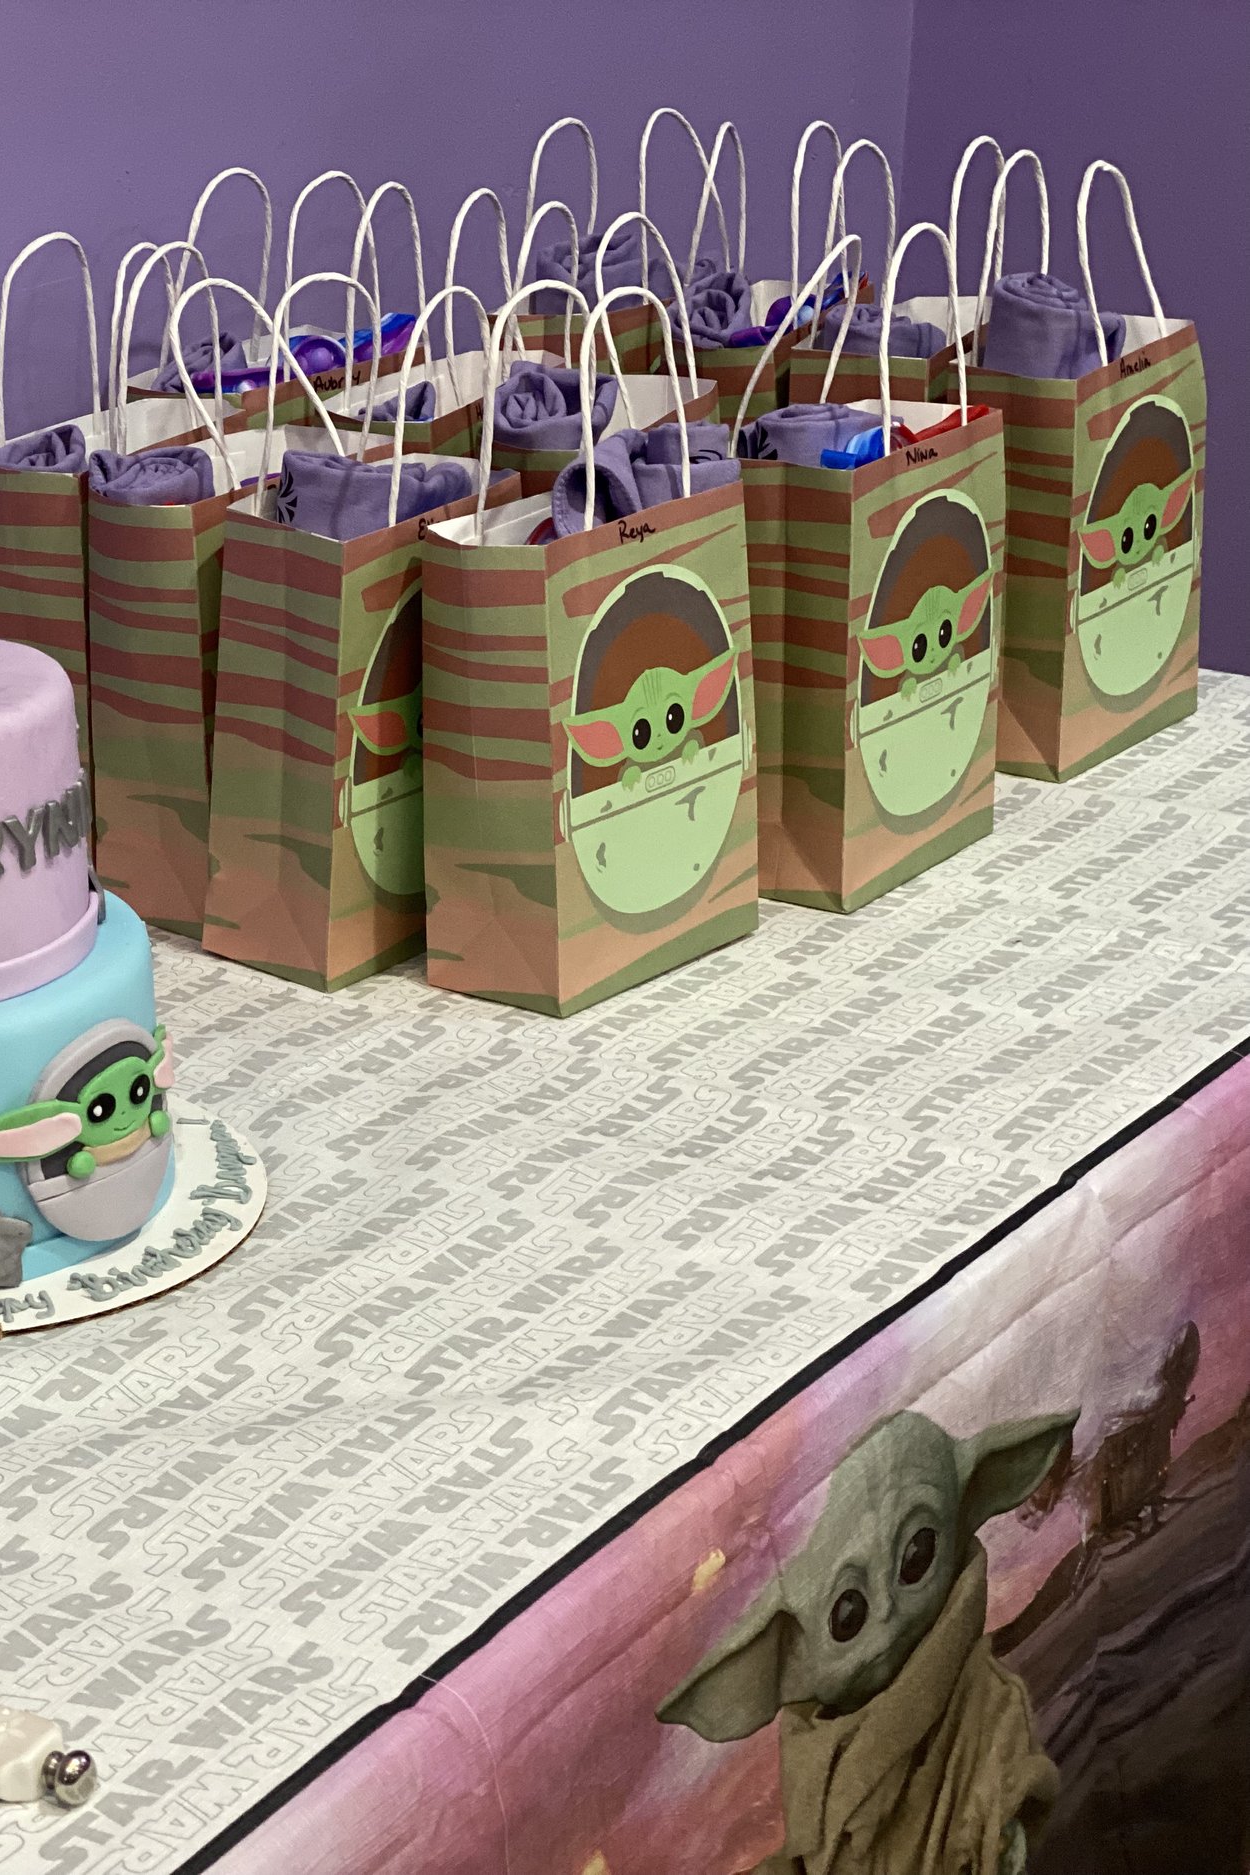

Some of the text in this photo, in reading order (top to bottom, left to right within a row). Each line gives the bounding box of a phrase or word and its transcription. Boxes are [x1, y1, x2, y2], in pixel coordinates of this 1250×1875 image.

[905, 446, 938, 466] Nina
[618, 520, 655, 542] Reya
[969, 843, 1056, 885] STAR
[1028, 793, 1116, 842] WARS
[1044, 806, 1192, 902] STAR WARS
[1124, 870, 1211, 916] STAR
[774, 917, 874, 967] WARS
[852, 932, 953, 984] WARS
[935, 952, 1032, 996] WARS
[1018, 963, 1116, 1016] WARS
[263, 1003, 375, 1048] STAR
[564, 955, 743, 1057] STAR WARS
[642, 970, 819, 1077] STAR WARS
[725, 984, 900, 1094] STAR WARS
[809, 1003, 985, 1115] STAR WARS
[1105, 984, 1201, 1031] WARS
[247, 1010, 450, 1139] STAR WARS
[326, 1036, 519, 1160] STAR WARS
[493, 1054, 604, 1116] STAR
[898, 1023, 1070, 1133] STAR WARS
[988, 1031, 1159, 1153] STAR WARS
[487, 1073, 685, 1199] STAR WARS
[568, 1095, 770, 1229] STAR WARS
[663, 1114, 858, 1251] STAR WARS
[221, 1180, 447, 1335] STAR WARS
[754, 1137, 949, 1277] STAR WARS
[851, 1157, 1044, 1301] STAR WARS
[309, 1207, 534, 1368] STAR WARS
[399, 1236, 622, 1399] STAR WARS
[586, 1261, 714, 1337] WARS
[118, 1347, 259, 1433] STAR
[587, 1283, 809, 1443] STAR WARS
[86, 1450, 241, 1554] WARS
[181, 1382, 441, 1595] STAR WARS
[279, 1417, 538, 1626] STAR WARS
[382, 1453, 636, 1663] STAR WARS
[63, 1604, 230, 1703] WARS
[47, 1640, 333, 1874] STAR WARS
